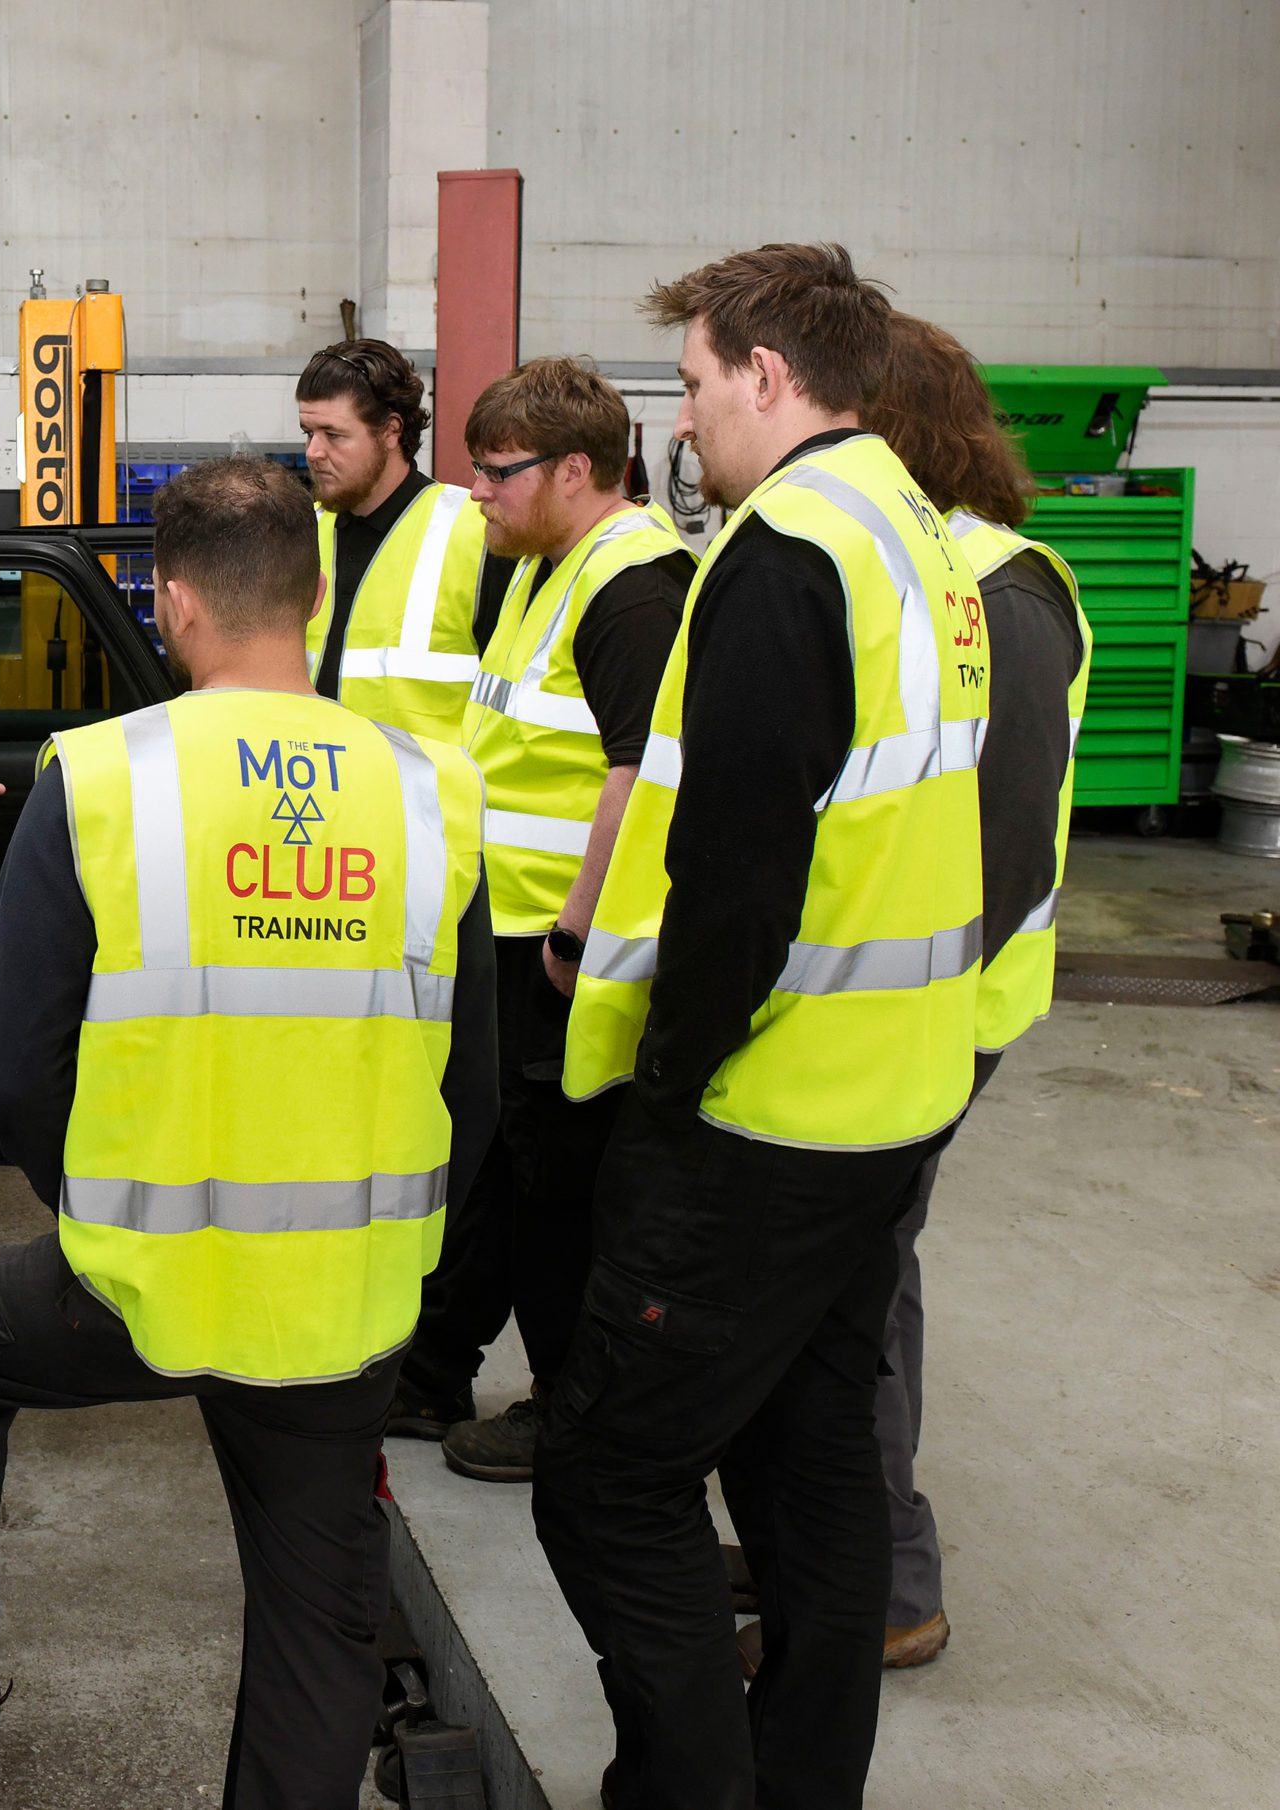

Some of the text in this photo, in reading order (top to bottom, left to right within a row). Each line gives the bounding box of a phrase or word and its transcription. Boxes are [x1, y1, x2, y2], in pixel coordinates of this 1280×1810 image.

[237, 738, 346, 792] MoT
[287, 740, 309, 752] THE
[226, 842, 376, 902] CLUB
[233, 915, 367, 942] TRAINING
